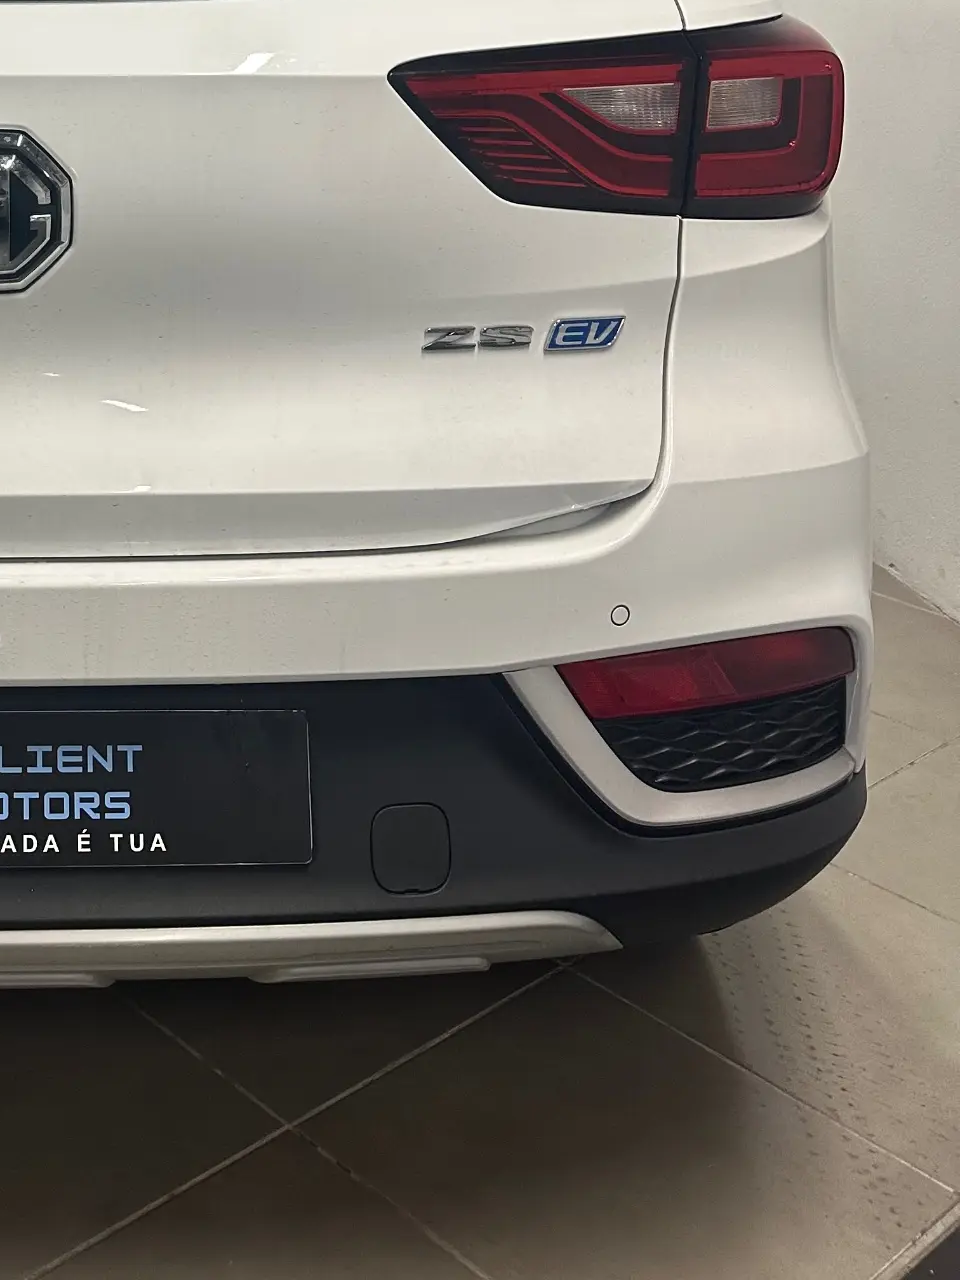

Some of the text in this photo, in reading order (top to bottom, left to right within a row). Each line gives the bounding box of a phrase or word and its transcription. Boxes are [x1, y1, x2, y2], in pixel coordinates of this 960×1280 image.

[421, 321, 619, 352] ZS EV
[77, 829, 91, 852] É
[110, 833, 167, 852] TUA
